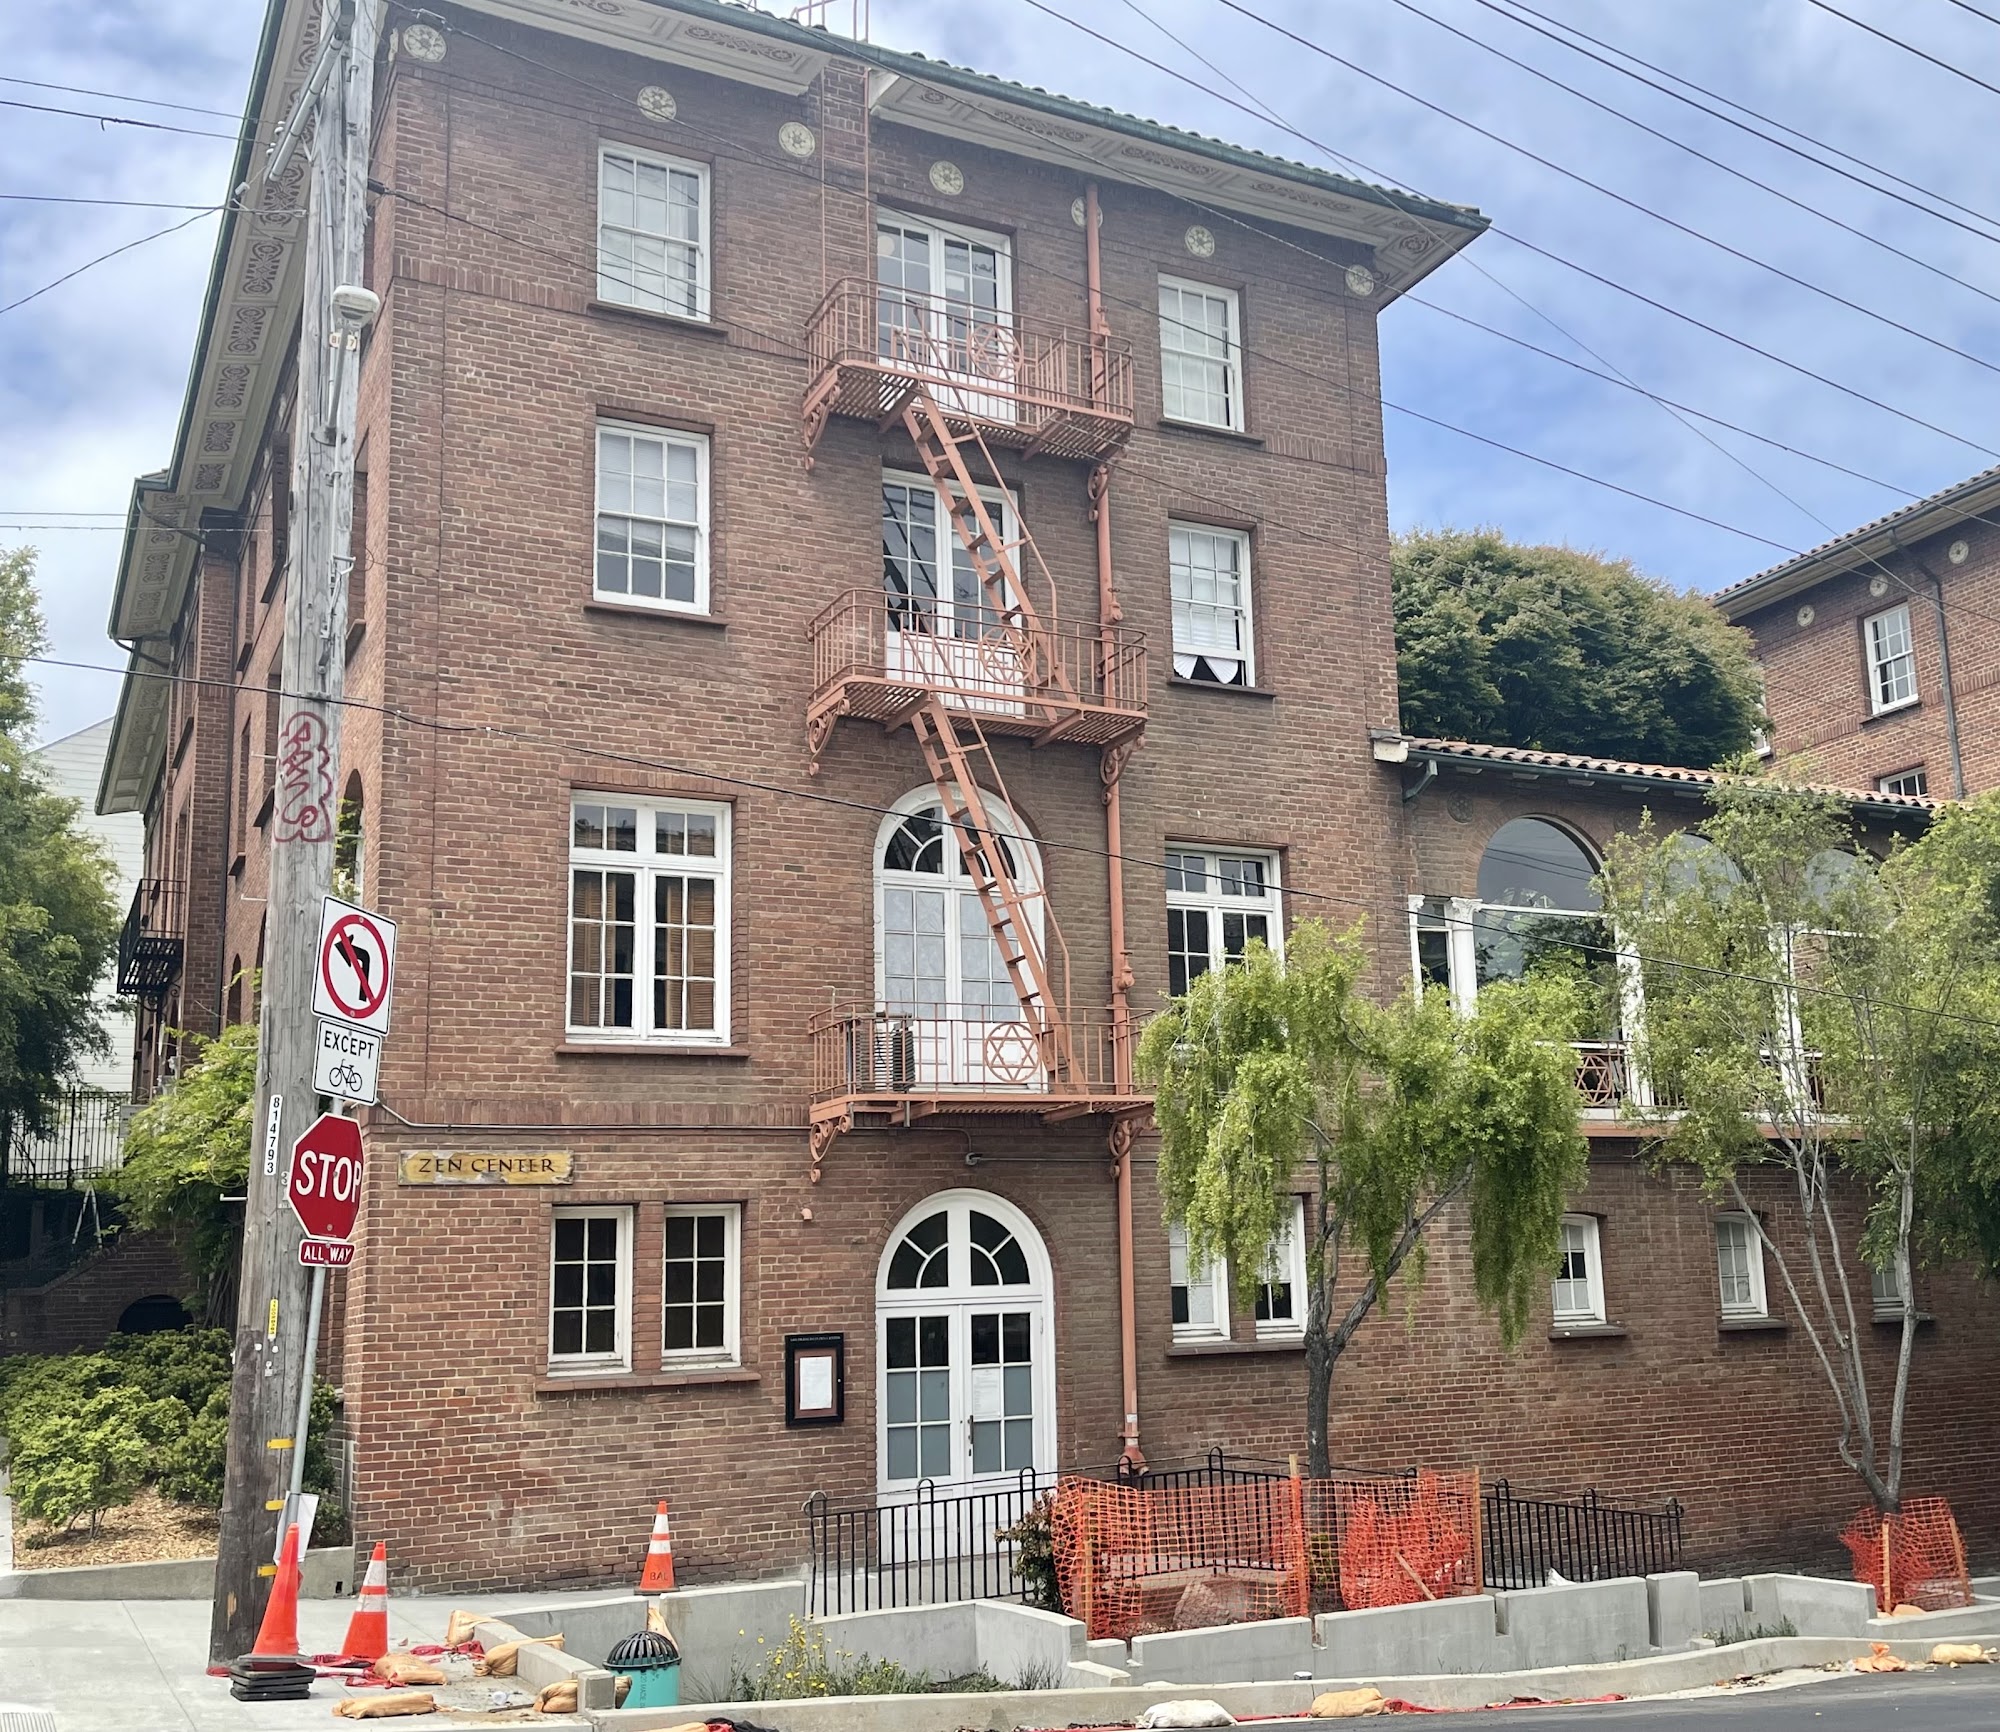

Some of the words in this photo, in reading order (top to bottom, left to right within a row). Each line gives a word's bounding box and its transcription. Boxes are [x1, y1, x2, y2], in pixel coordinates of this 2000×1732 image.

[324, 1030, 374, 1060] EXCEPT
[266, 1096, 280, 1174] 814793
[295, 1150, 362, 1203] STOP
[418, 1158, 462, 1173] ZEN
[471, 1158, 556, 1173] CENTER
[303, 1245, 324, 1260] ALL
[329, 1247, 352, 1262] WAY
